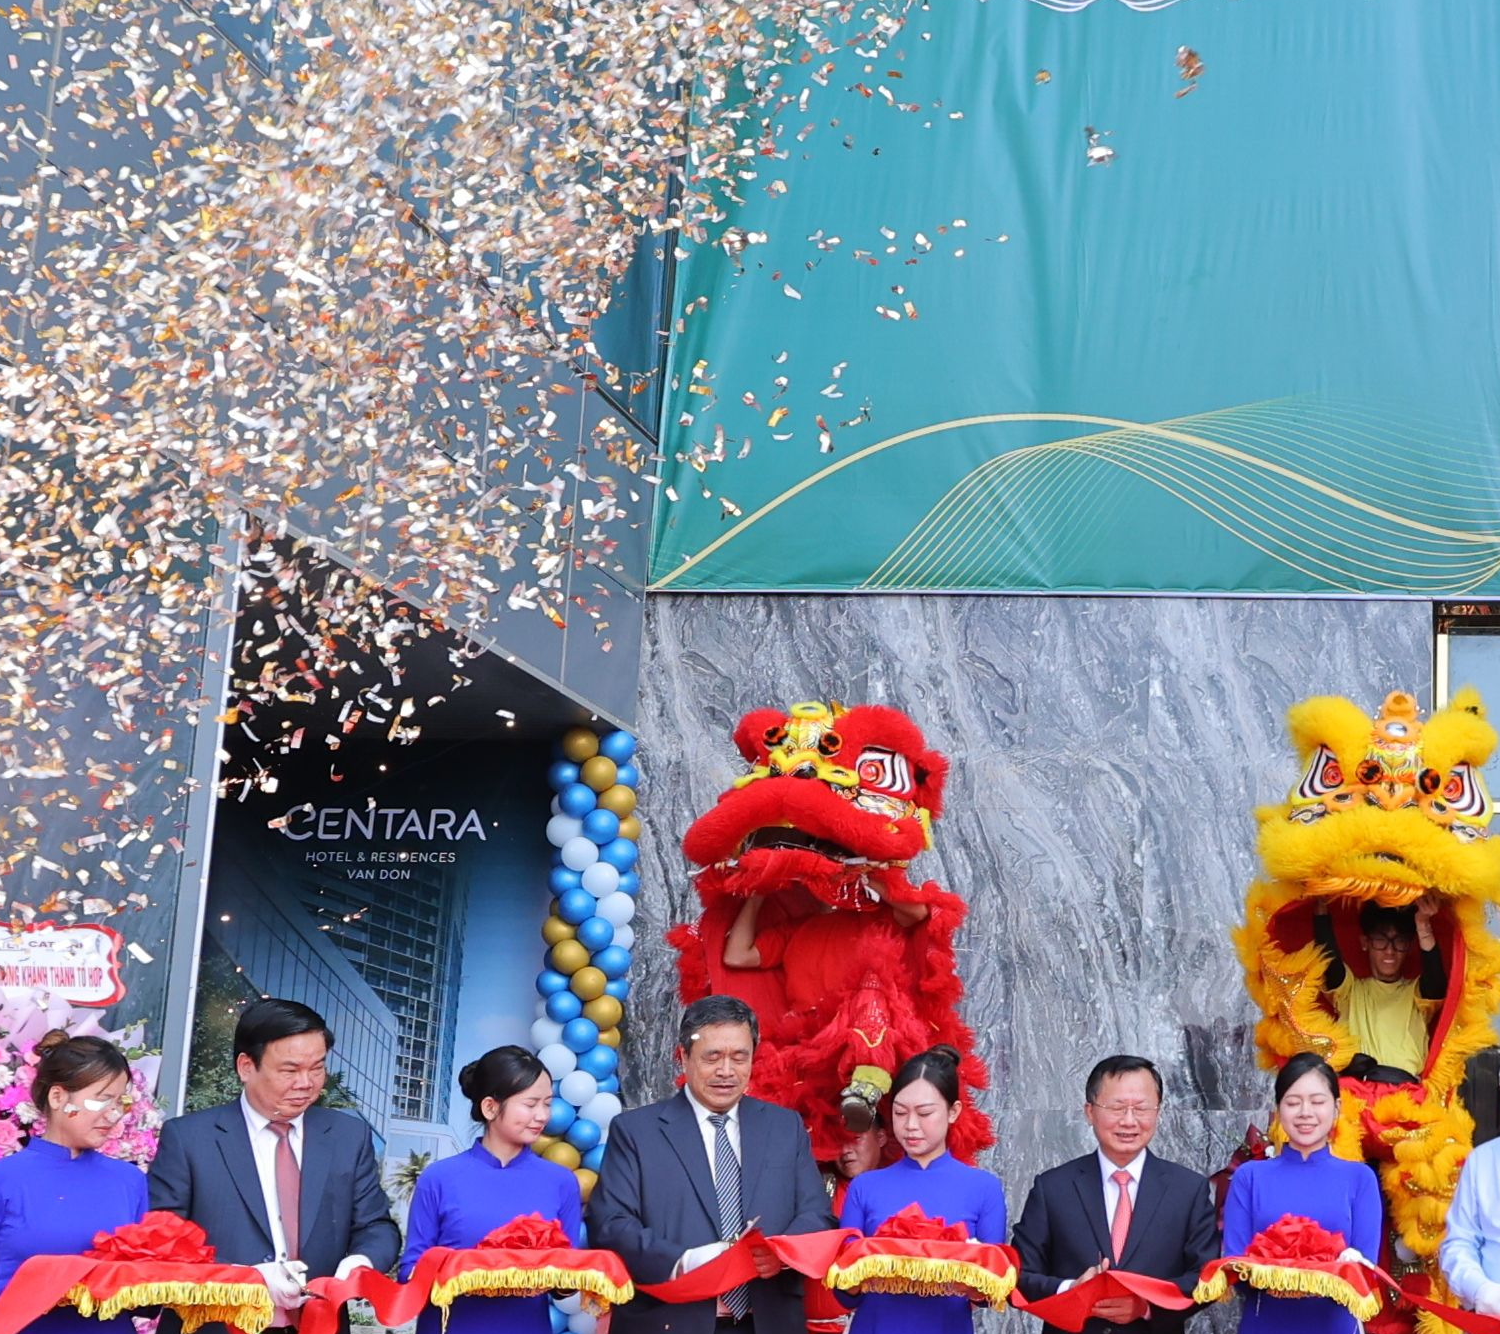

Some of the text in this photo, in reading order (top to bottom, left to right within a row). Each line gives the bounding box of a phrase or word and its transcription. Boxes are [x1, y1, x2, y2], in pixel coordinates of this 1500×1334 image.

[283, 805, 488, 842] CENTARA
[305, 851, 457, 863] HOTEL & RESIDENCES
[346, 869, 411, 881] VAN DON
